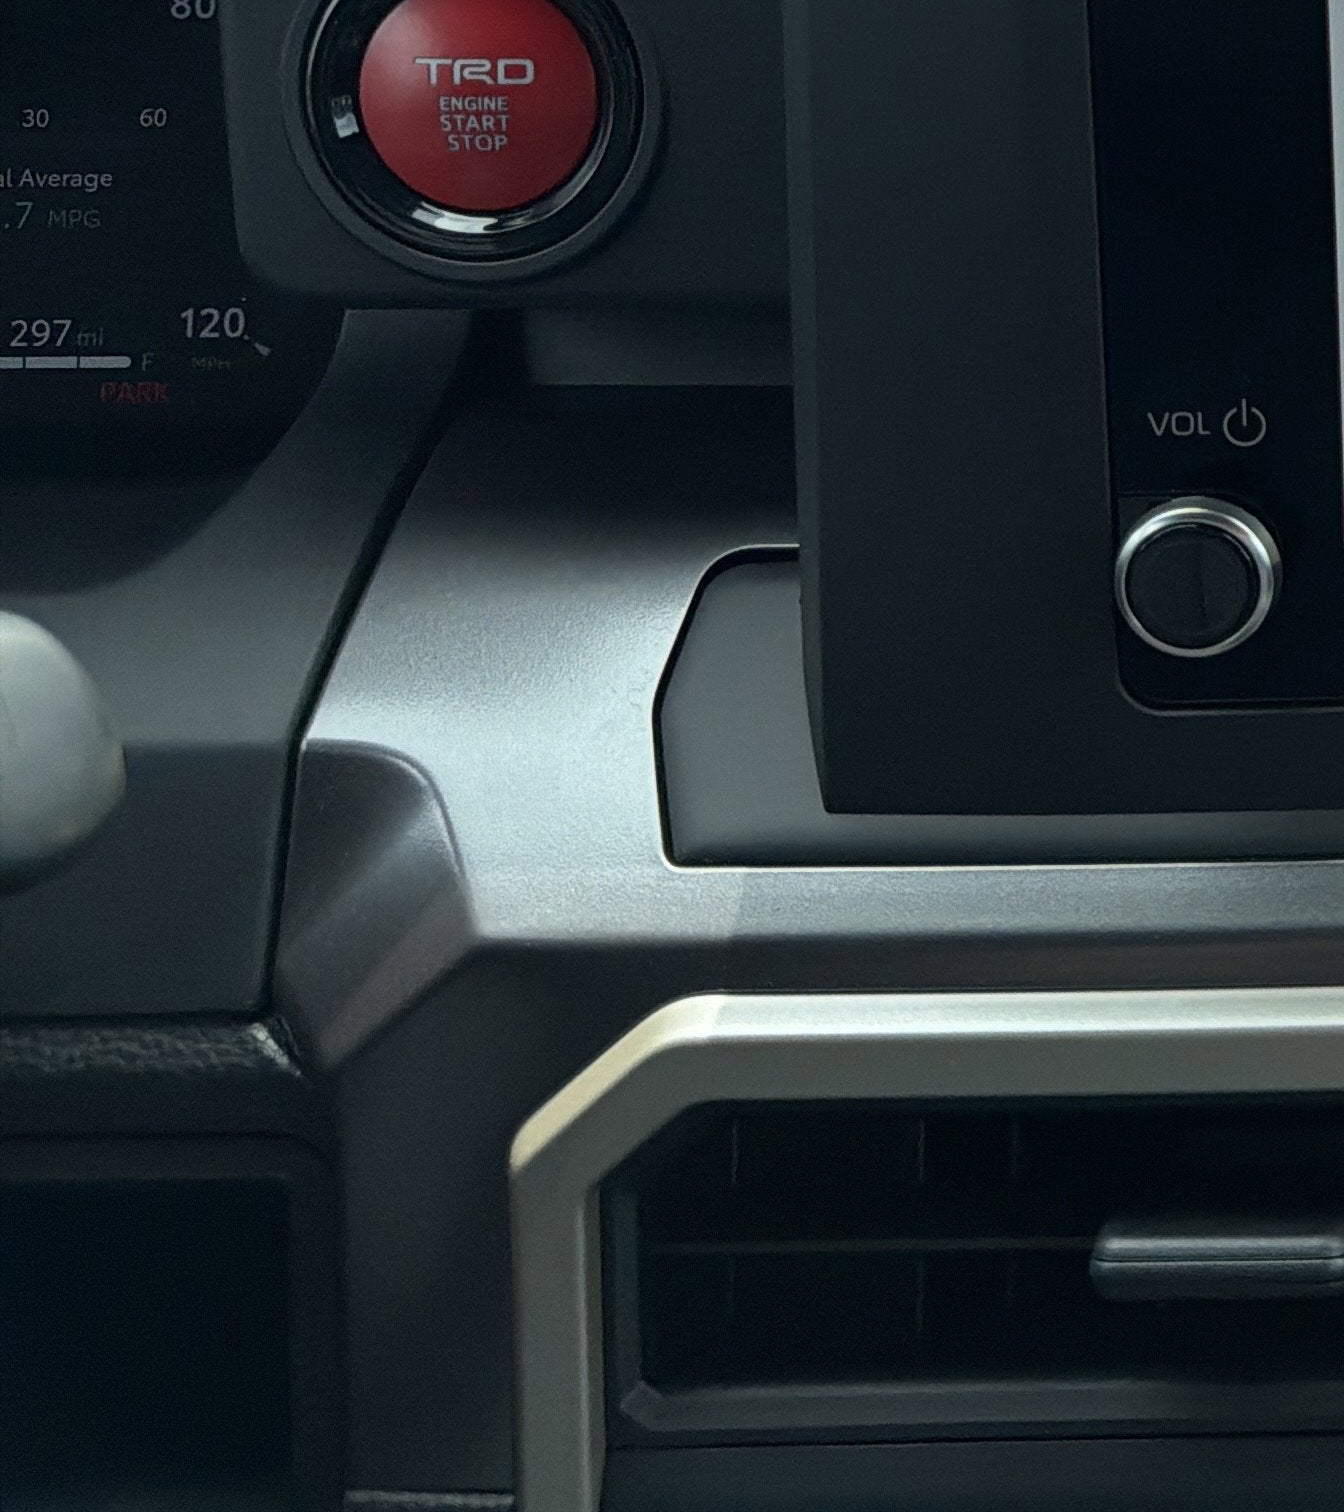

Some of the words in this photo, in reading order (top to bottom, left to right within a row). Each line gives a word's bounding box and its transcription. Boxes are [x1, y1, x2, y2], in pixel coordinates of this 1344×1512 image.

[414, 57, 535, 85] TRD
[439, 96, 508, 111] ENGINE
[22, 108, 50, 128] 30
[139, 107, 168, 128] 60
[439, 114, 510, 132] START
[447, 134, 508, 151] STOP
[18, 168, 113, 192] Average
[48, 208, 101, 229] MPG
[9, 319, 72, 347] 297
[180, 307, 247, 339] 120
[1147, 411, 1211, 437] VOL
